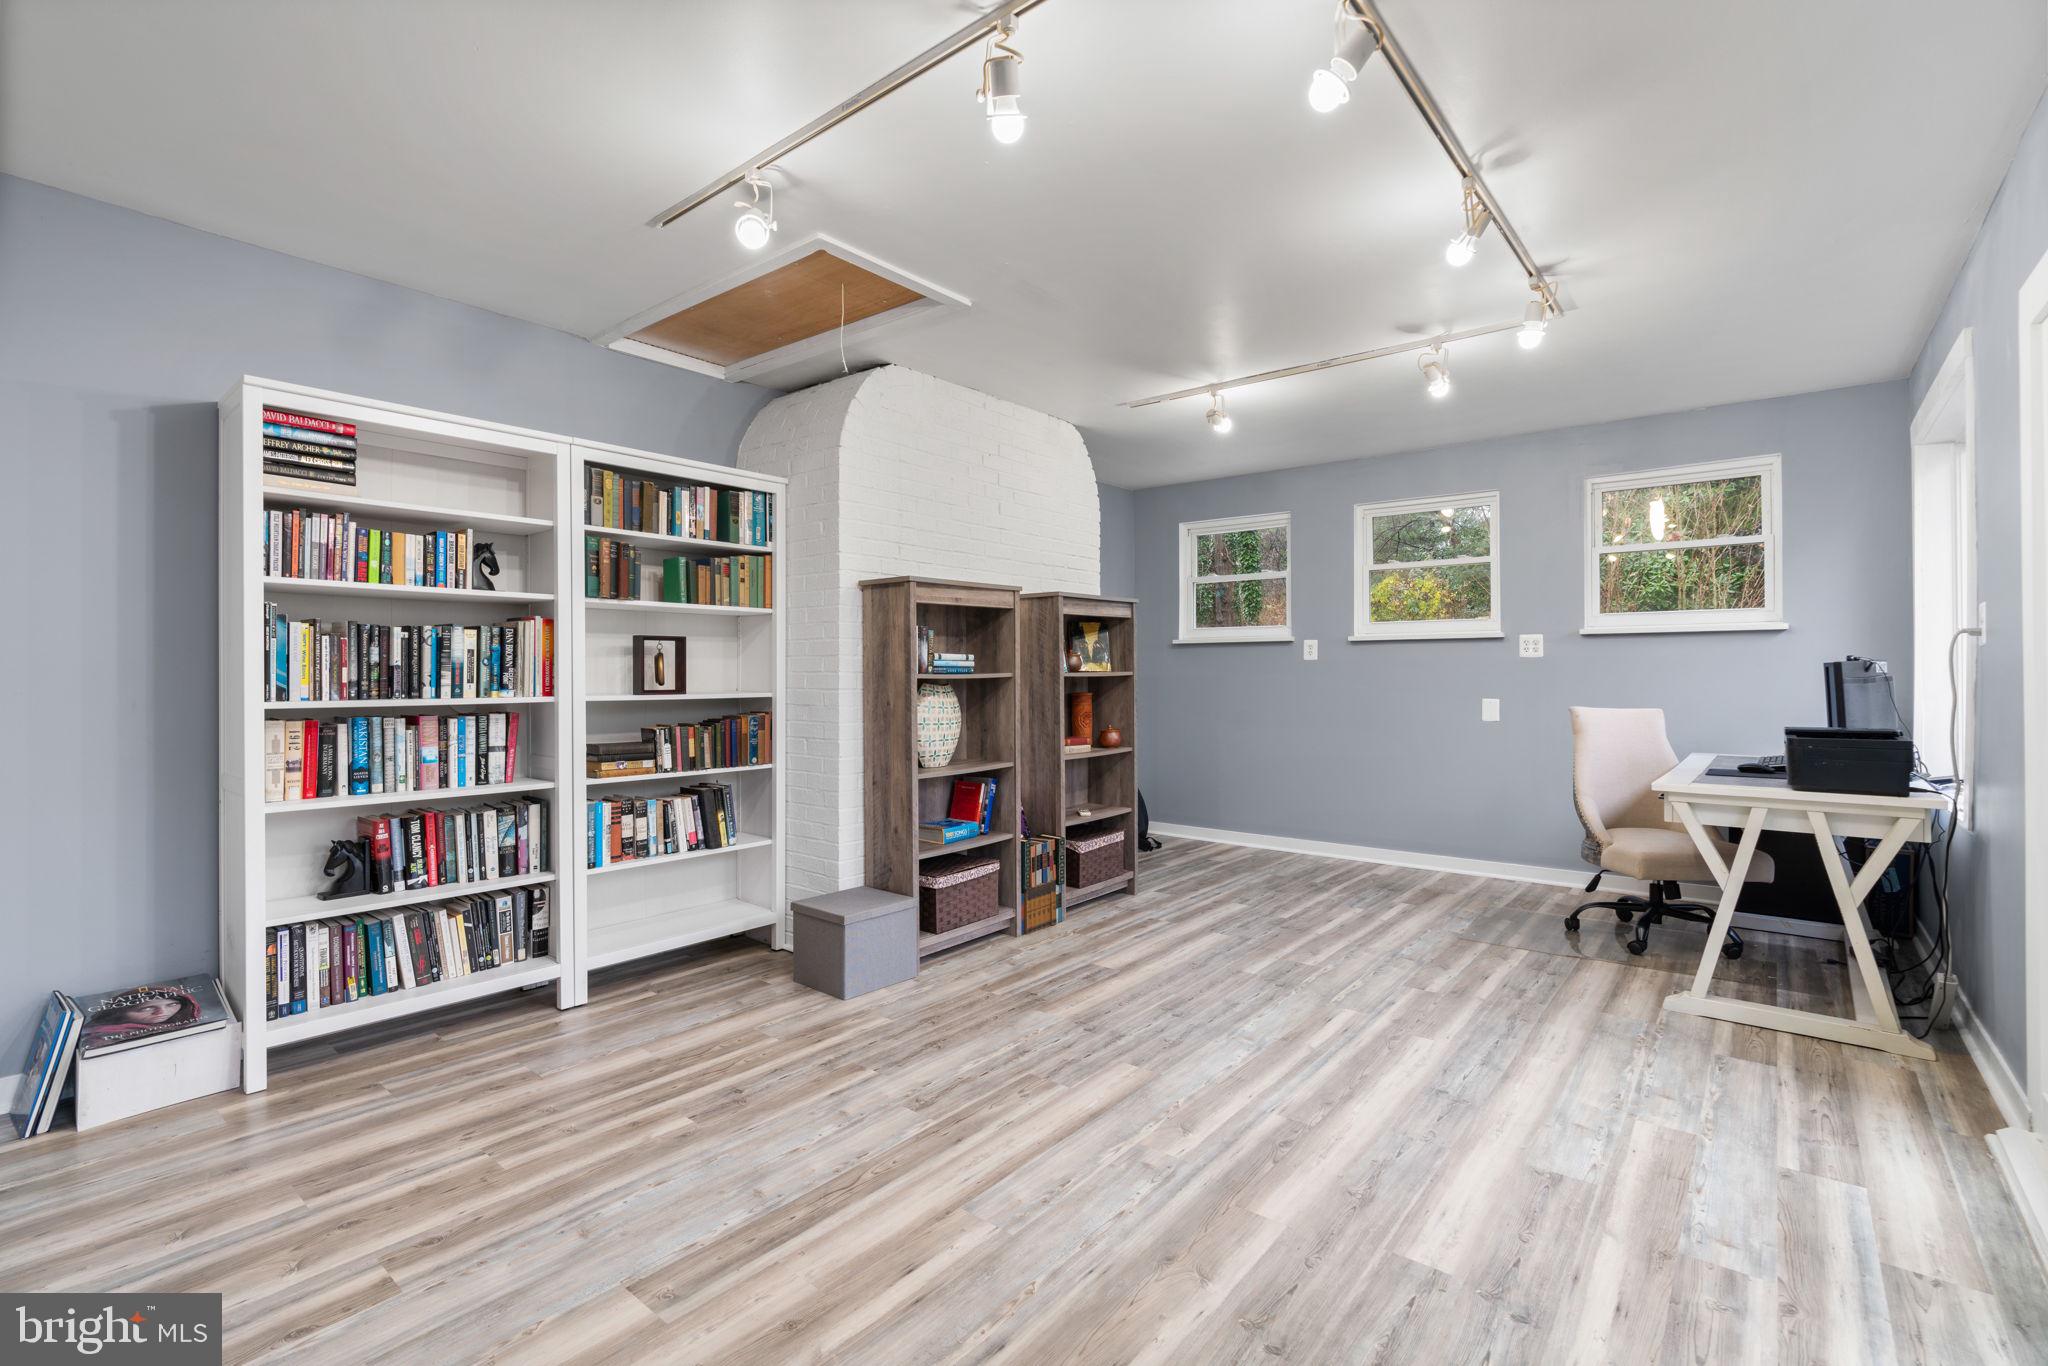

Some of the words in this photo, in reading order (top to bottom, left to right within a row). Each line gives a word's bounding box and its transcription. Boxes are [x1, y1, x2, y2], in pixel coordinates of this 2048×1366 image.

[288, 414, 330, 429] BALDACCI
[263, 438, 289, 448] EFFREY
[292, 443, 320, 453] ARCHER
[505, 644, 513, 667] BROWN
[479, 716, 488, 733] PATRICIA
[358, 720, 368, 764] PAKISTAN
[478, 734, 487, 754] CORNWELL
[411, 820, 420, 833] TOM
[412, 835, 422, 858] CLANCY
[88, 985, 204, 1013] GEOGRAPHIC
[100, 984, 190, 1004] NATIONAL
[103, 1032, 127, 1041] THE
[129, 1015, 209, 1037] PHOTOGRAPHS
